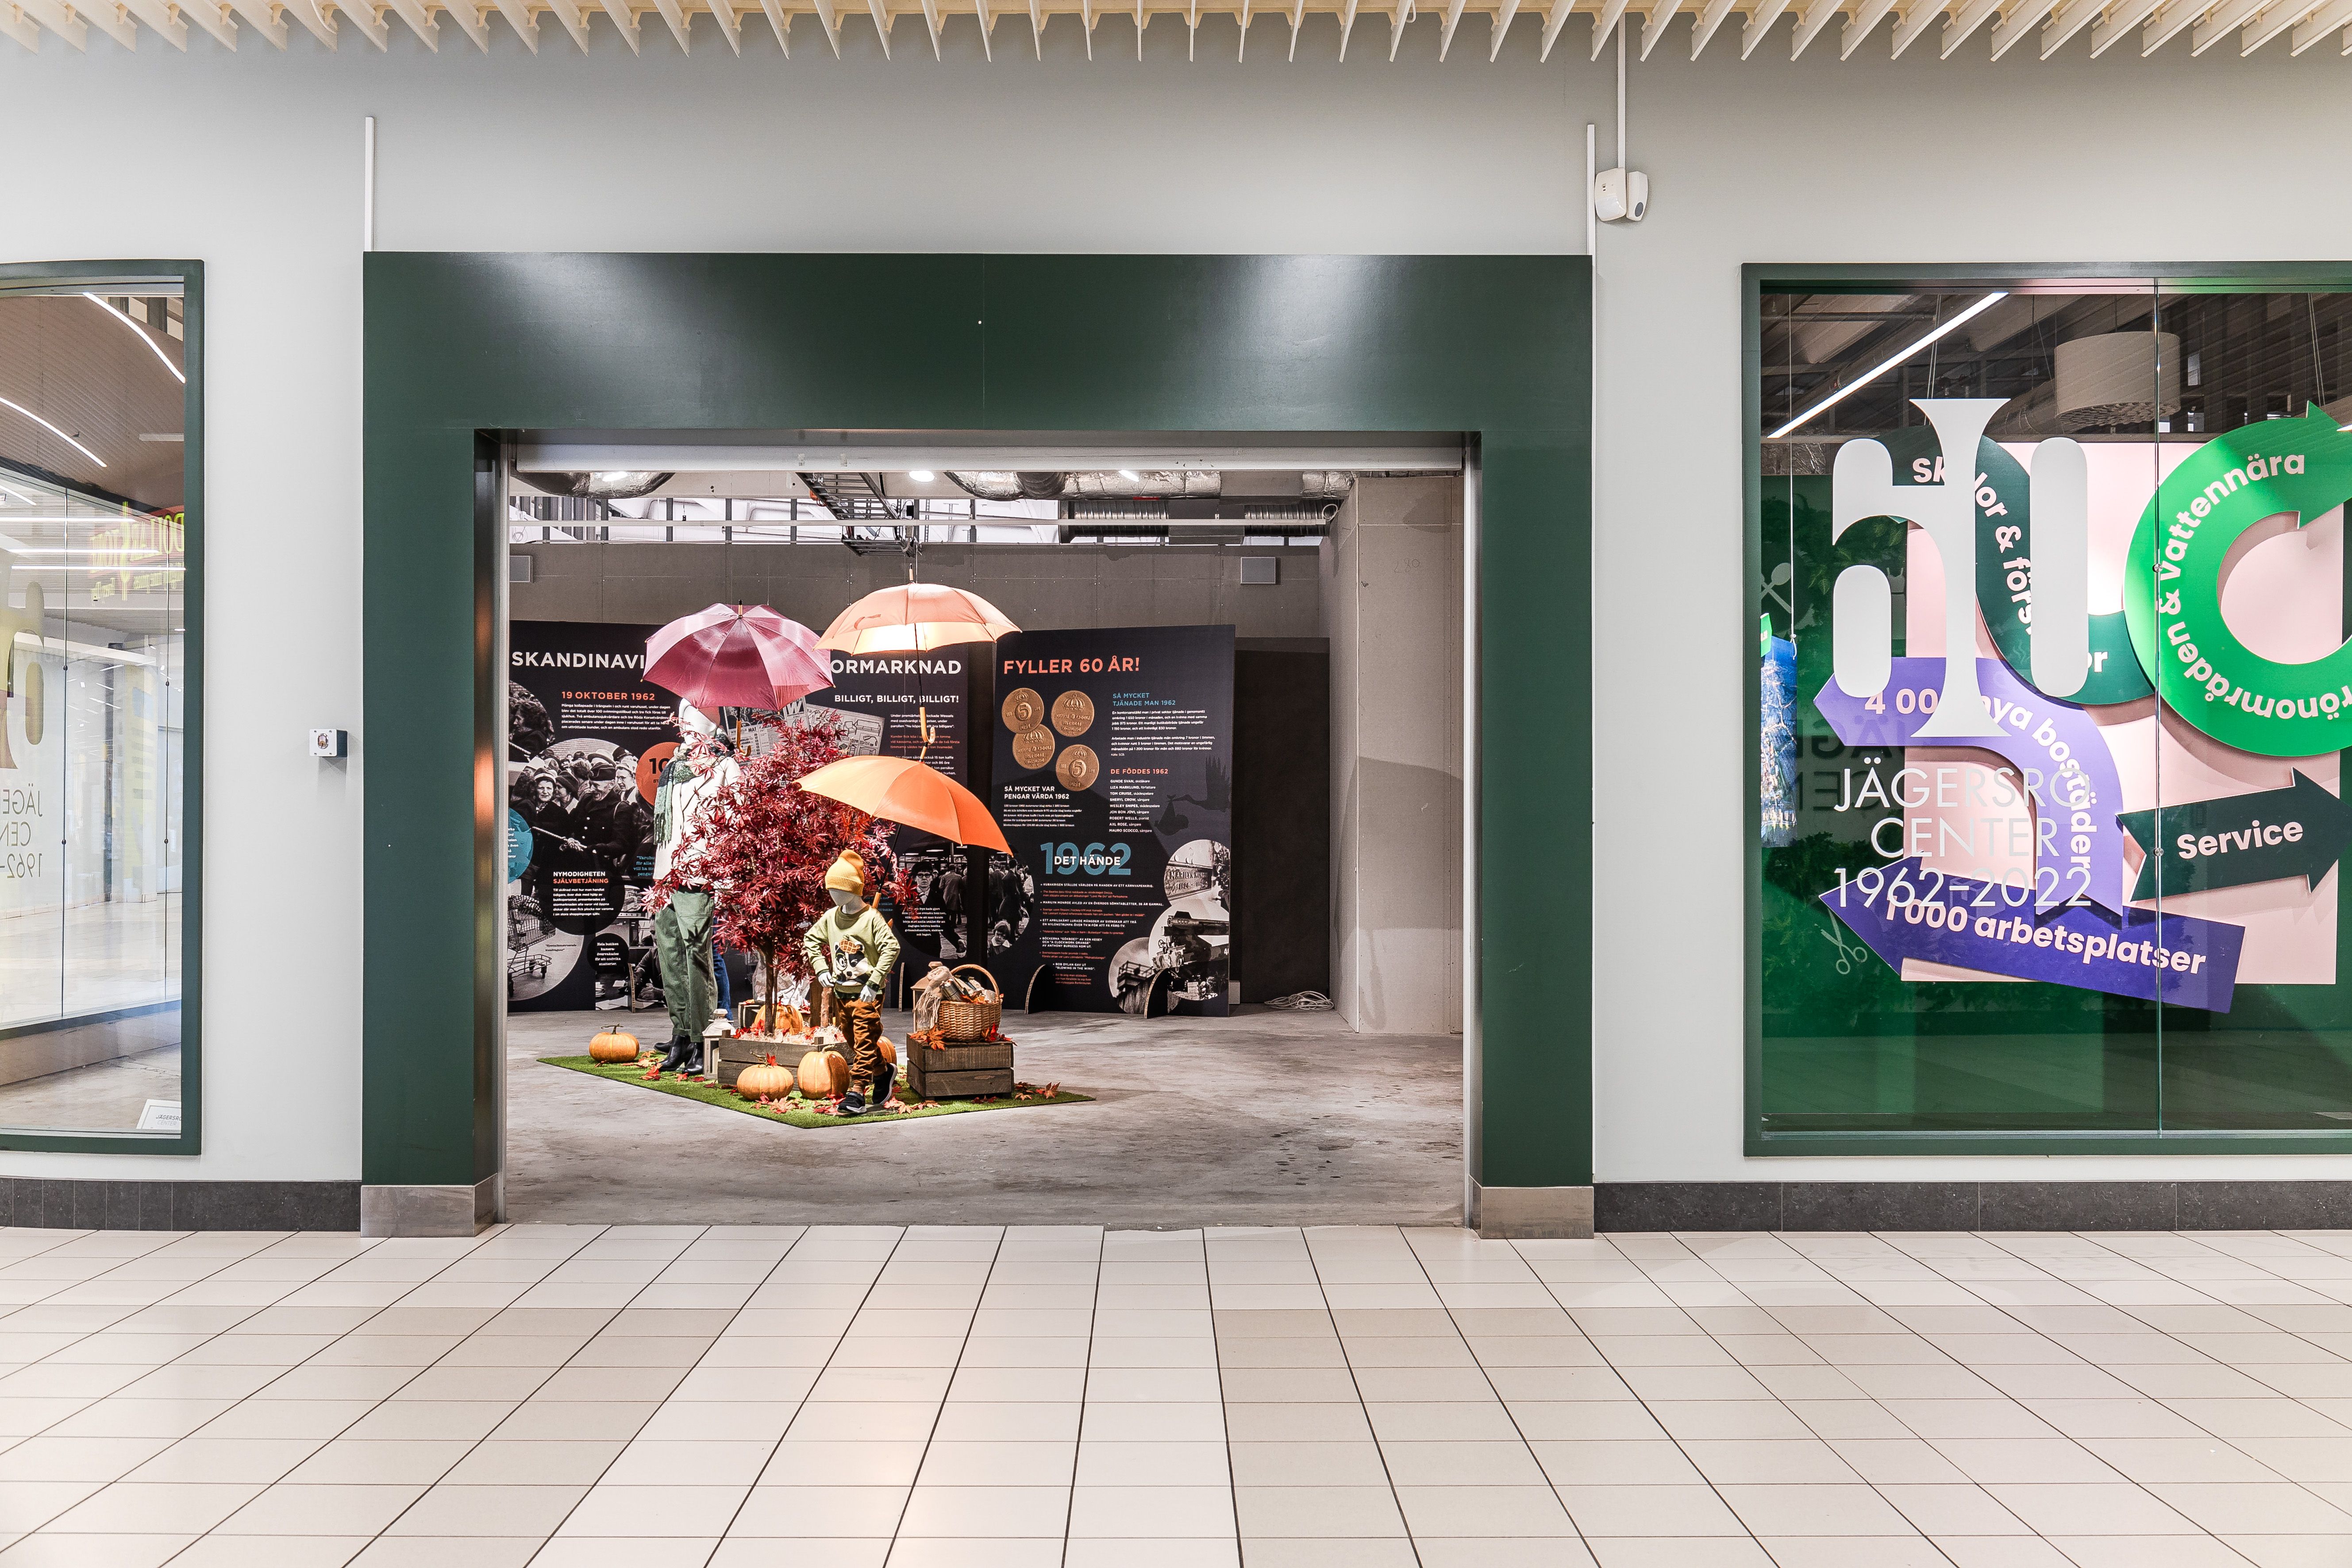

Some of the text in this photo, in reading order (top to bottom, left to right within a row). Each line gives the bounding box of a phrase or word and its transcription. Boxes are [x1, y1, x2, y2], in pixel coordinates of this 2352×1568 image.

[2160, 453, 2305, 581] Vattennära
[1995, 525, 2022, 553] &
[2157, 588, 2182, 615] &
[511, 651, 644, 669] SKANDINAVI
[830, 659, 961, 674] ORMARKNAD
[1004, 655, 1139, 674] FYLLER 60 ÅR!
[575, 692, 627, 700] OKTOBER
[835, 695, 959, 704] BILLIGT, BILLIGT, BILLIGT!
[1019, 704, 1029, 719] 5
[1072, 761, 1082, 776] 5
[1833, 757, 2090, 812] JÄGERSRO
[2031, 718, 2098, 871] bostäder
[1871, 817, 2060, 858] CENTER
[2177, 820, 2303, 859] Service
[1040, 842, 1131, 876] 1962
[1054, 854, 1121, 866] DET HÄNDE
[1974, 915, 2206, 974] arbetsplatser
